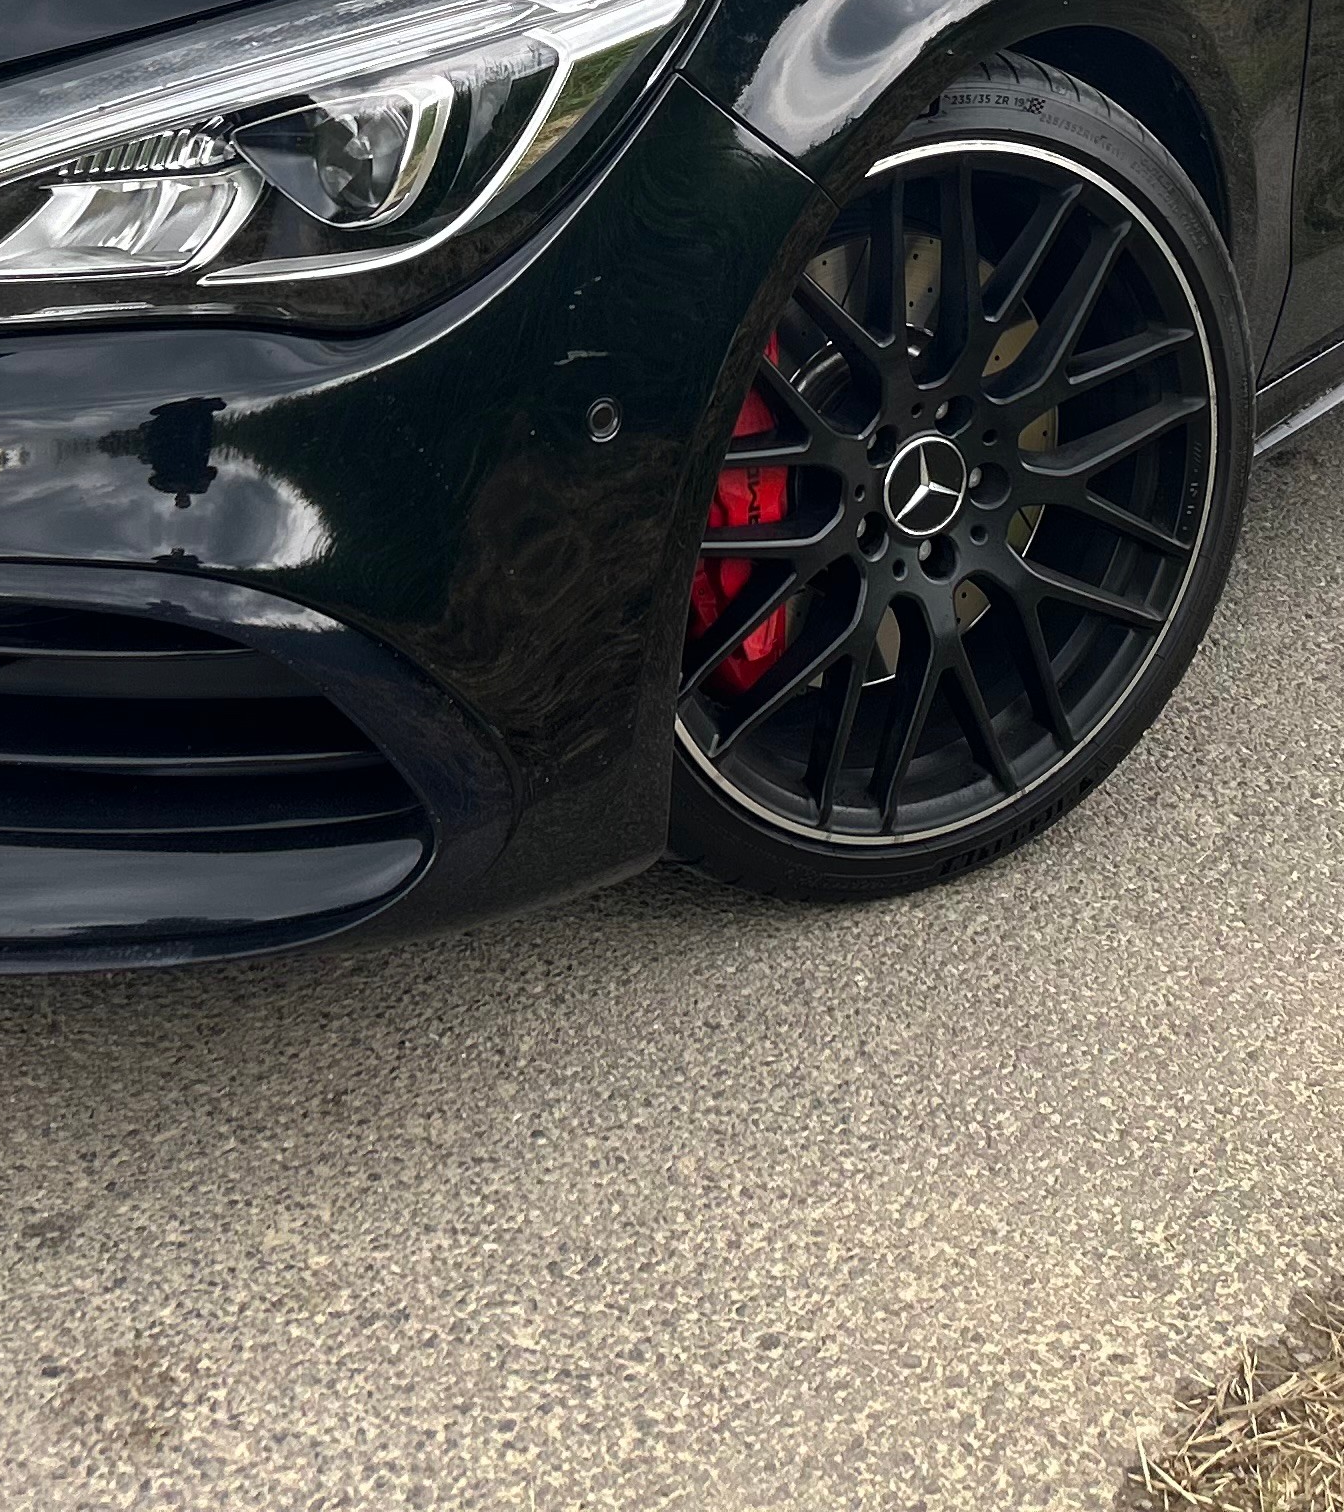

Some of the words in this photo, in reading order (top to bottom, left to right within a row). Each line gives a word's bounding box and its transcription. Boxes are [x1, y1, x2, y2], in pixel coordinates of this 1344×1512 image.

[950, 93, 992, 105] 235/35
[994, 94, 1010, 105] ZR
[1013, 96, 1025, 108] 19
